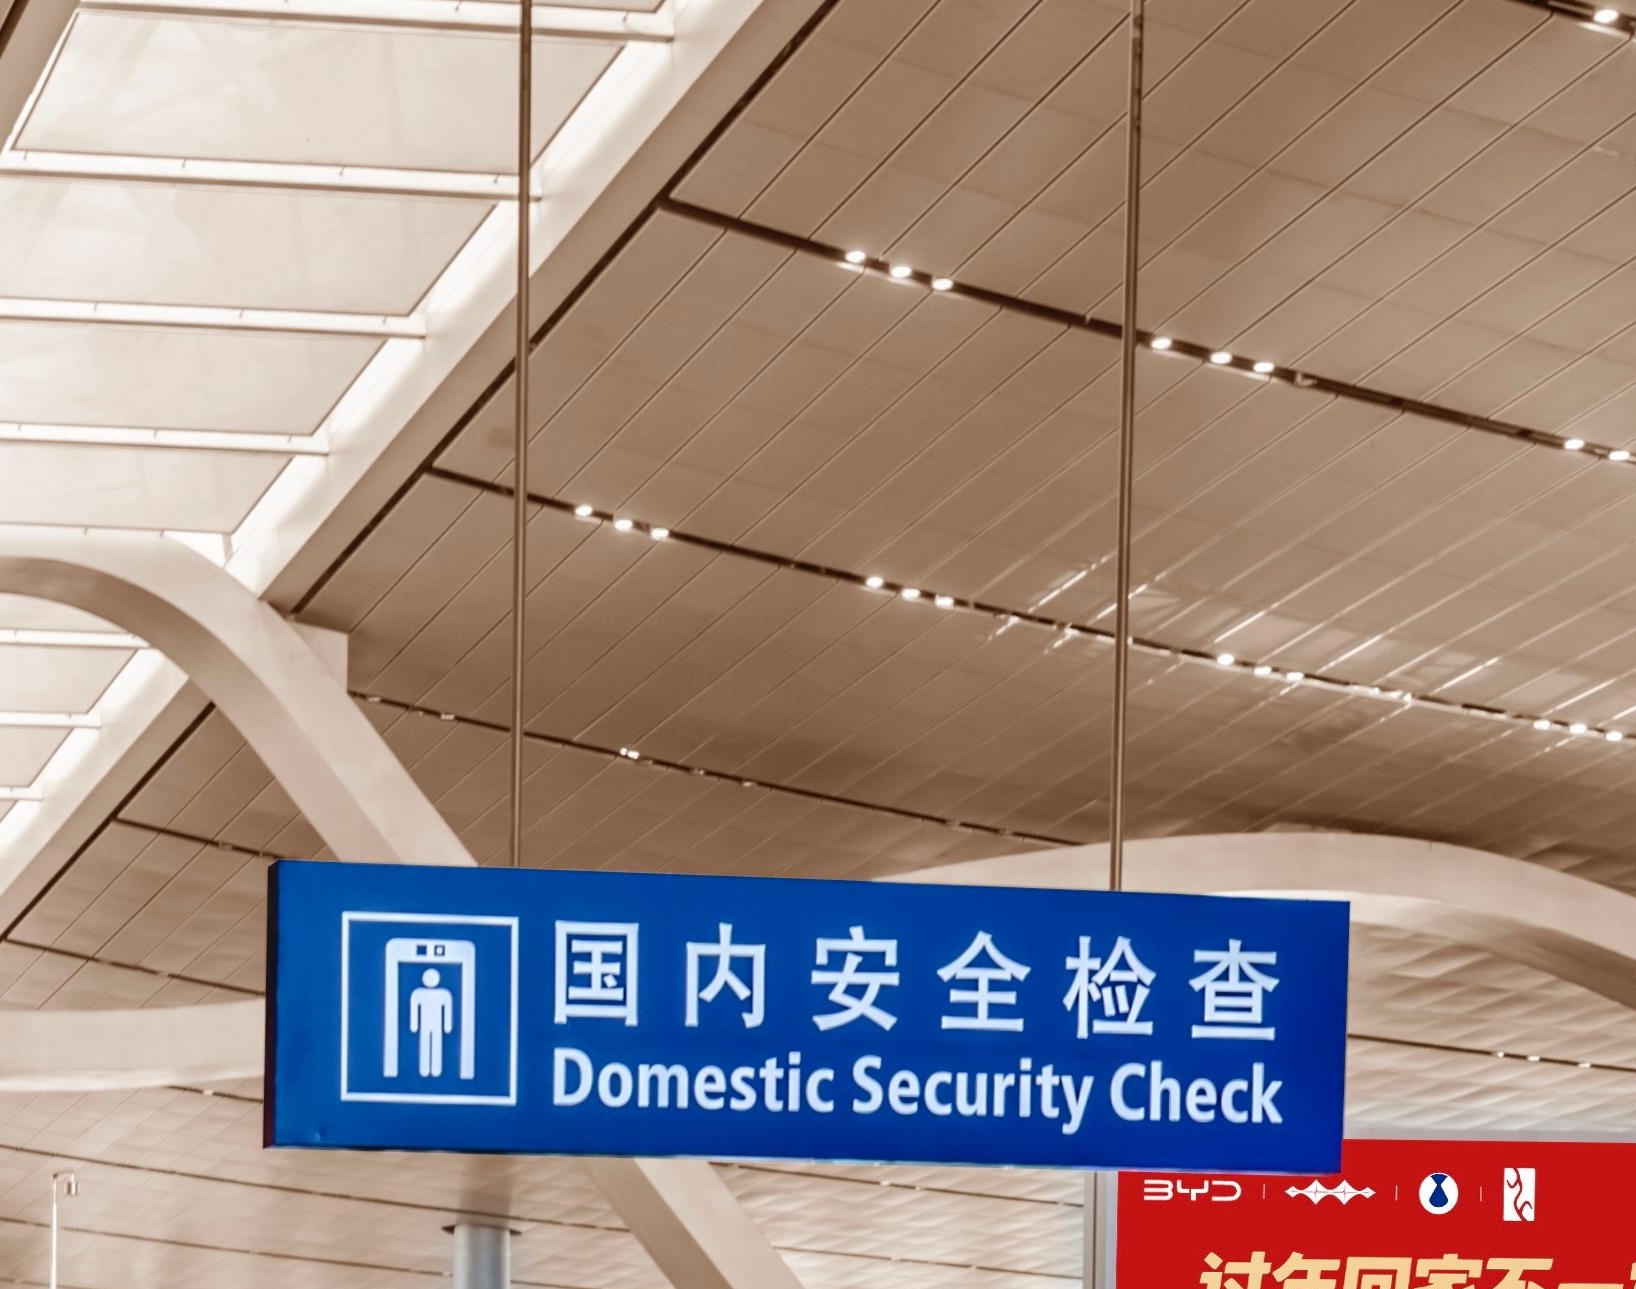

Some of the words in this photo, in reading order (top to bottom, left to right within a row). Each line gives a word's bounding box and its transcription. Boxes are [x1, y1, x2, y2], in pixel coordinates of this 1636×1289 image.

[552, 919, 1280, 1042] 国内安全检查
[551, 1047, 834, 1113] Domestic
[852, 1055, 1092, 1134] Security
[1109, 1062, 1283, 1125] Check
[1142, 1178, 1242, 1202] BYD
